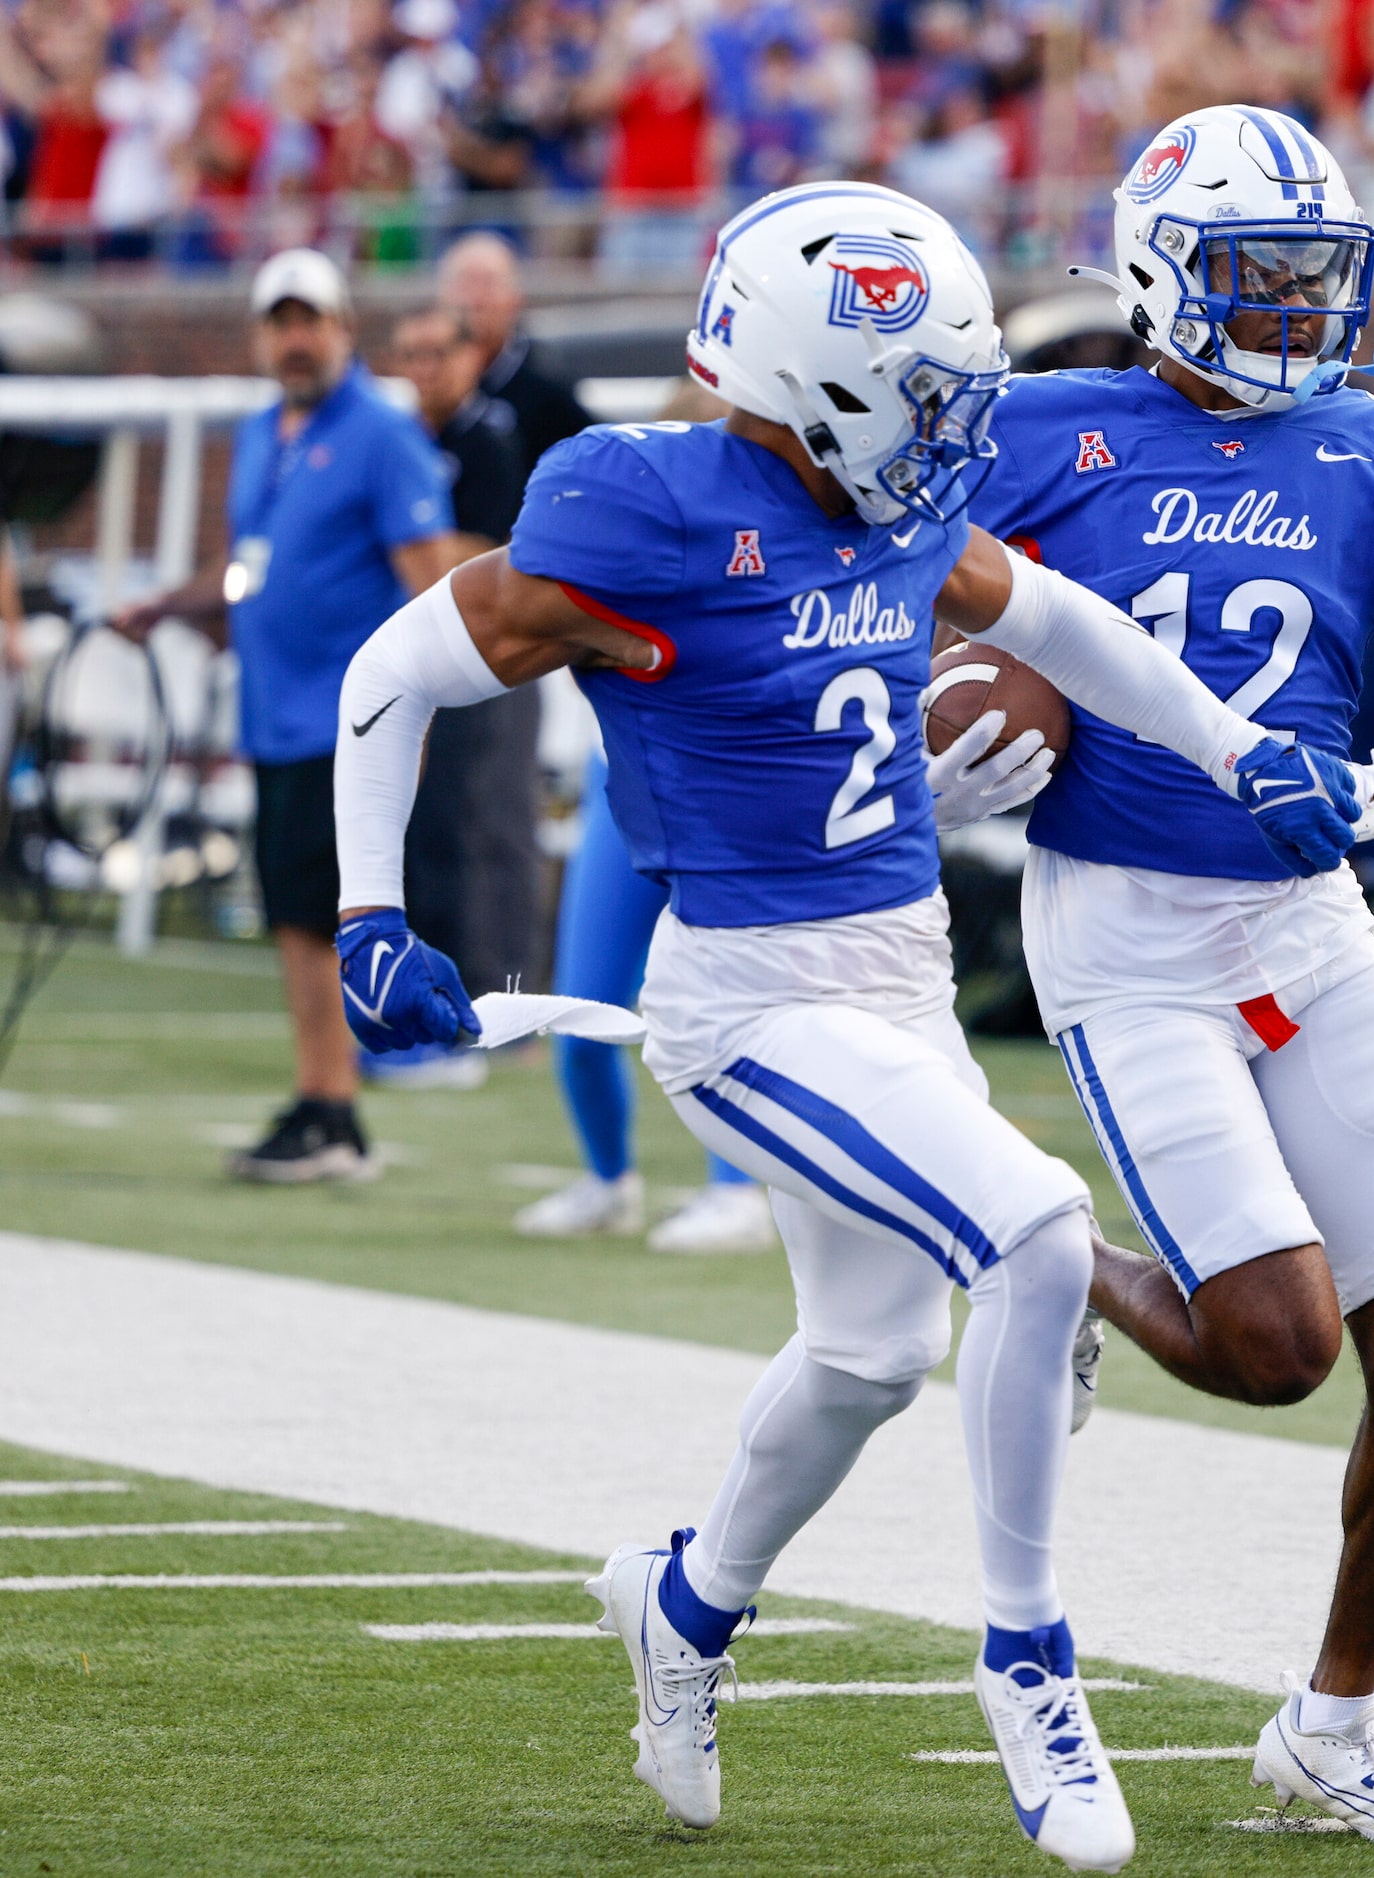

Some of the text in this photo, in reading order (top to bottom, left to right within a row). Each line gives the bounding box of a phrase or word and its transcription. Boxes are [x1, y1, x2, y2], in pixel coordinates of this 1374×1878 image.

[1215, 206, 1241, 218] Dallas
[1297, 202, 1323, 218] 214
[1075, 430, 1116, 473] A
[1142, 487, 1318, 550] Dallas
[726, 530, 766, 576] A
[782, 581, 916, 649] Dallas
[1132, 572, 1313, 746] 12
[814, 666, 897, 850] 2
